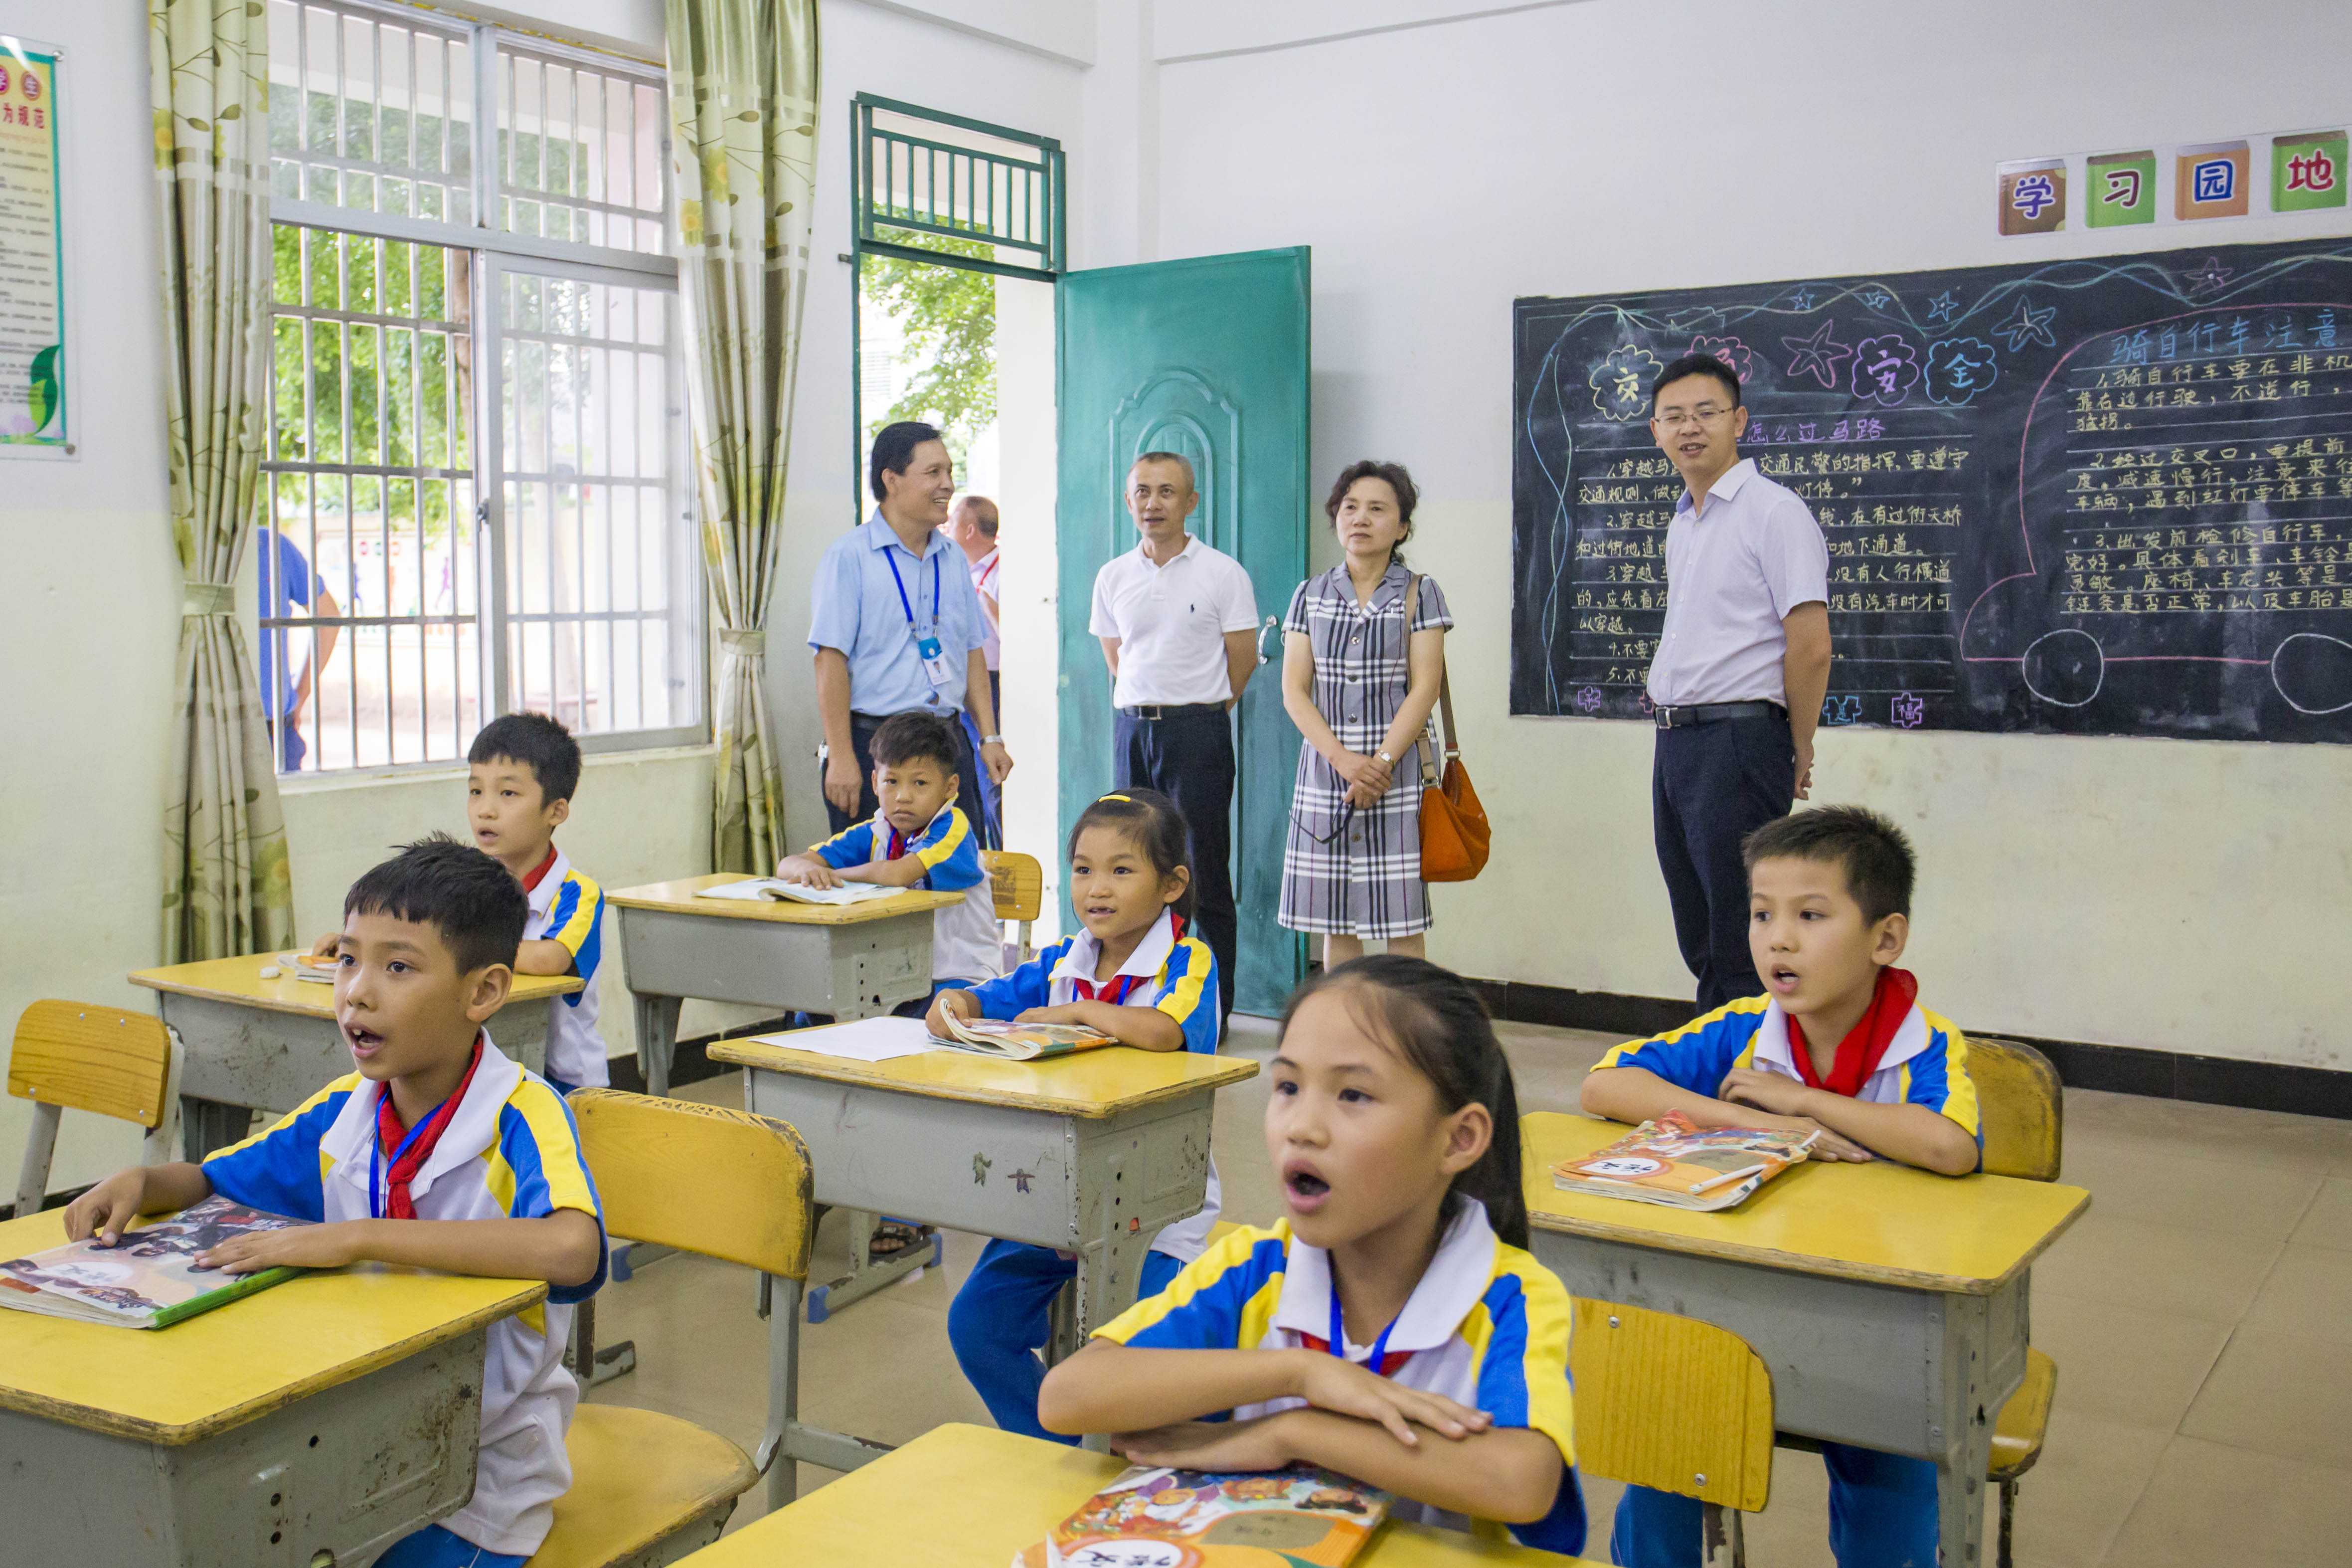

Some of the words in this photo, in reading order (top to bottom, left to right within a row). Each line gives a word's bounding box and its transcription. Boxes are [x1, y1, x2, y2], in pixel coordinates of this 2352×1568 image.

[2110, 309, 2337, 365] 骑自行车注意
